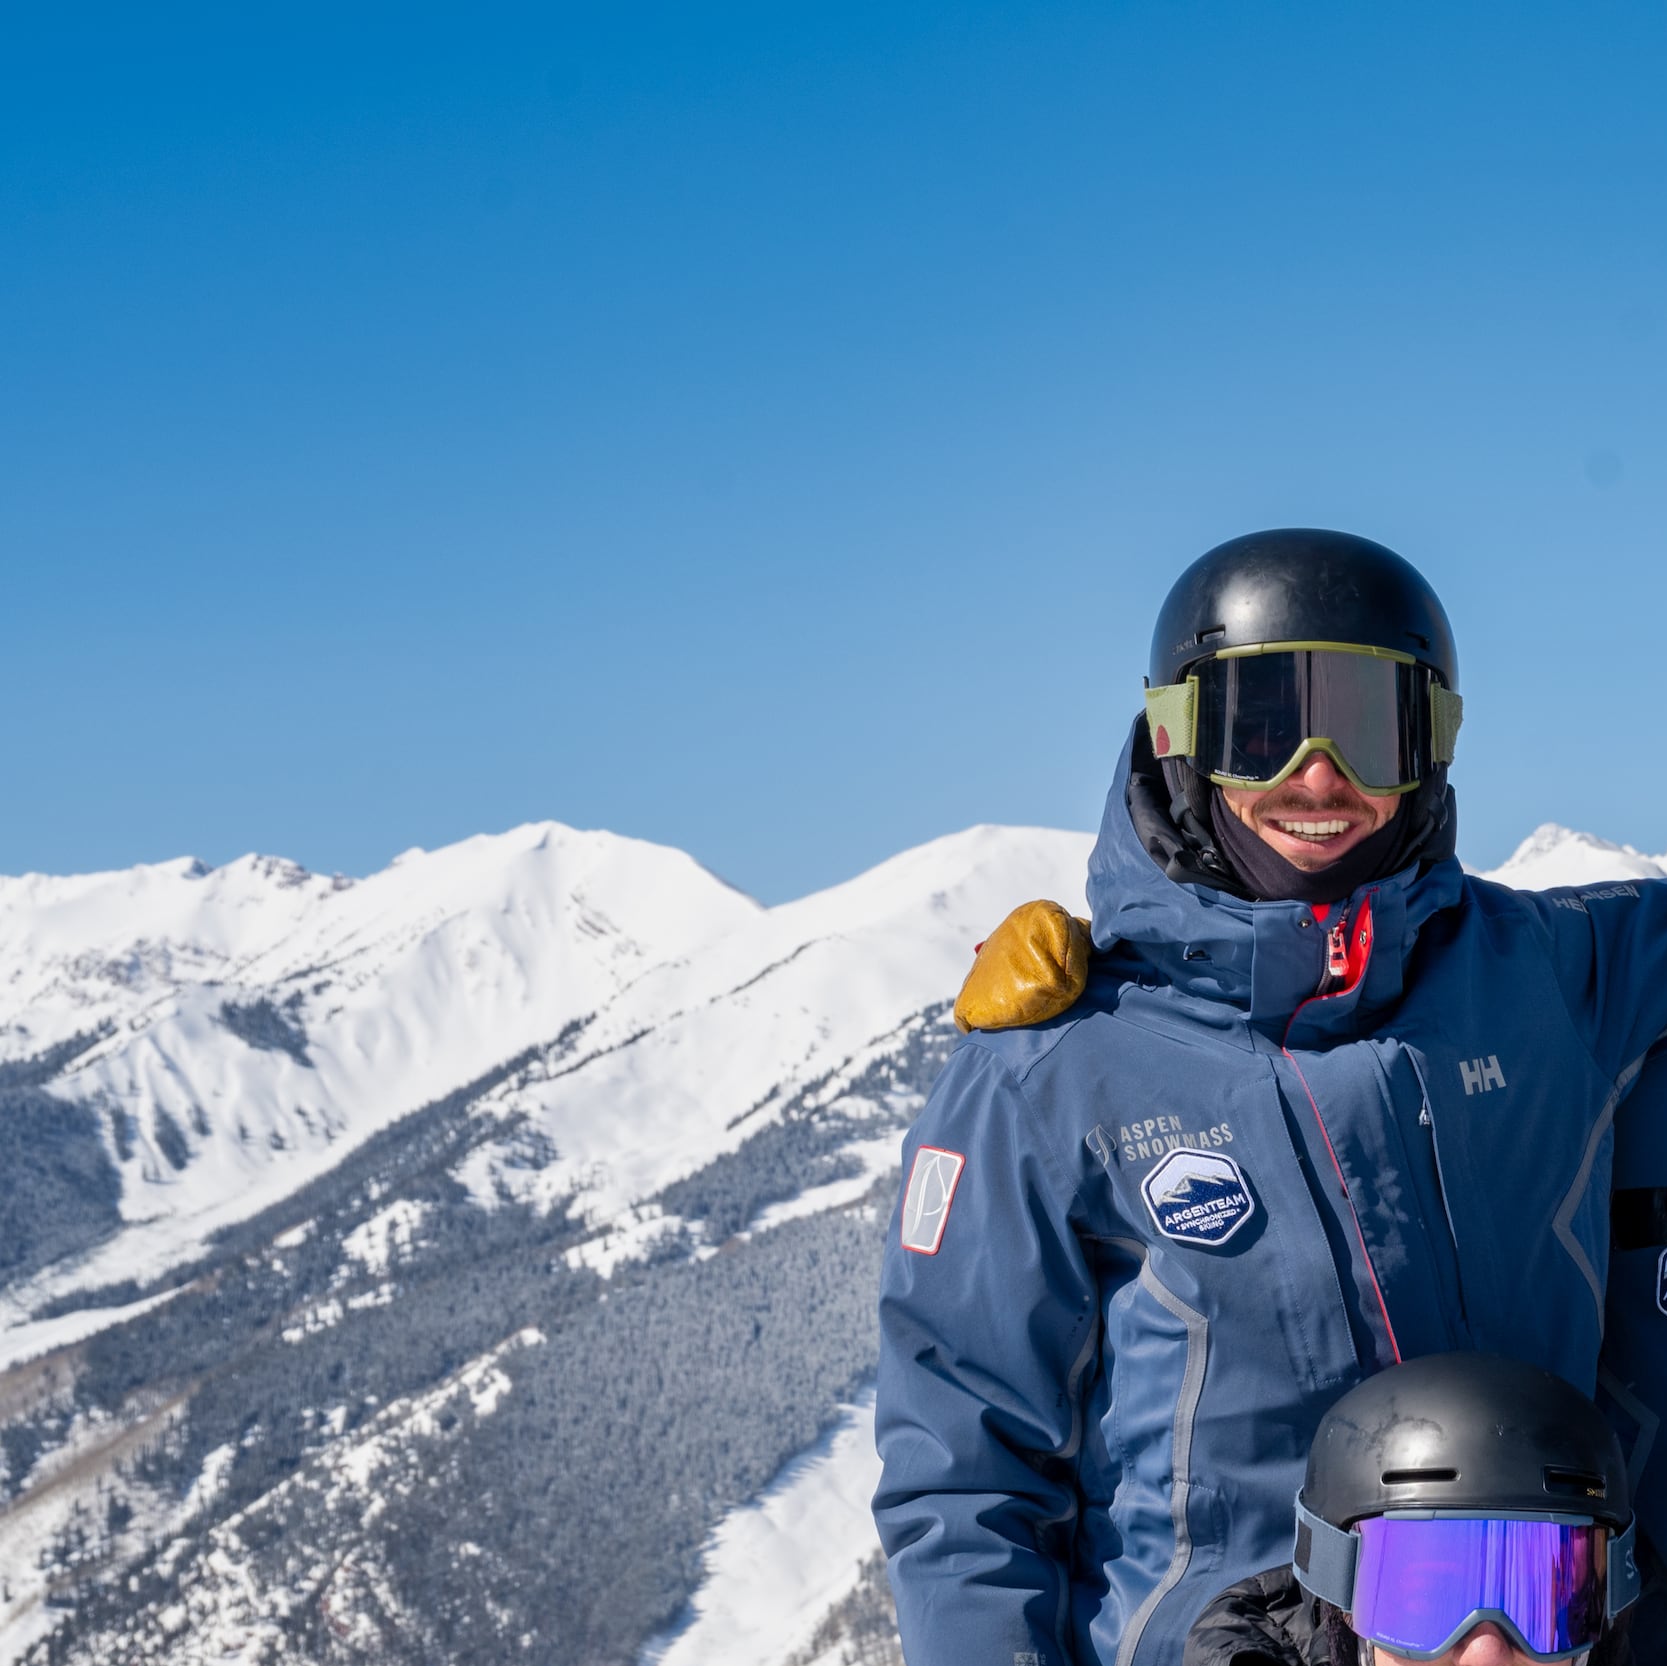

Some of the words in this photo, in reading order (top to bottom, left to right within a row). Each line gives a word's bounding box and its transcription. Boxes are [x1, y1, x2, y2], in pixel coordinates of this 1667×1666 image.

[1459, 1055, 1507, 1095] HH
[1120, 1115, 1182, 1143] ASPEN
[1124, 1122, 1234, 1162] SNOWMASS
[1165, 1193, 1246, 1226] ARGENTEAM
